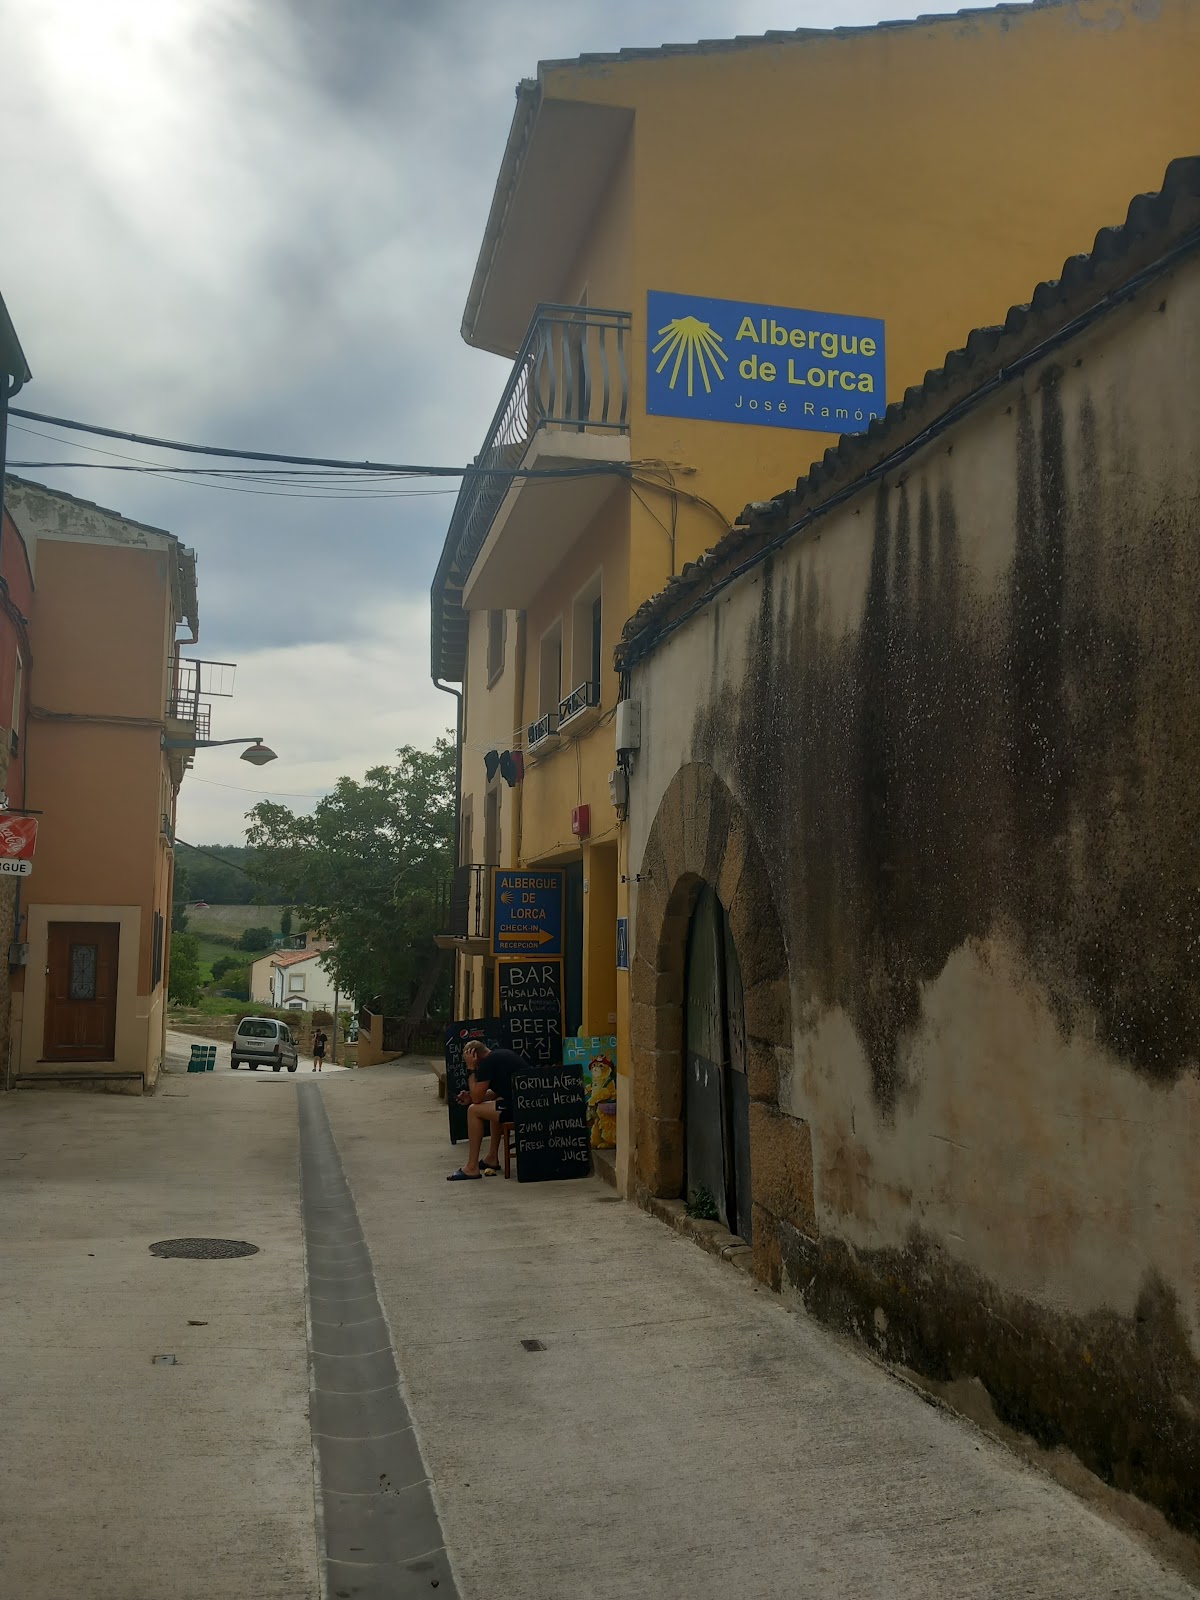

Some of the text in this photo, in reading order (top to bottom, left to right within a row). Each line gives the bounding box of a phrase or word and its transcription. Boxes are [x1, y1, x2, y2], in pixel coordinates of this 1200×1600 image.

[735, 316, 877, 359] Albergue
[738, 354, 875, 393] de Lorca
[734, 395, 878, 422] José Ramón
[0, 862, 27, 873] GUE
[500, 877, 557, 889] ALBERGUE
[521, 892, 536, 904] DE
[510, 908, 547, 919] LORCA
[500, 924, 539, 932] CHECK-IN
[509, 965, 556, 986] BAR
[500, 985, 555, 998] ENSALADA
[510, 1018, 560, 1034] BEER
[553, 1092, 583, 1105] HECHA
[519, 1117, 586, 1134] ZUMO NATURAL
[548, 1135, 587, 1148] ORANGE
[561, 1150, 589, 1162] JUICE
